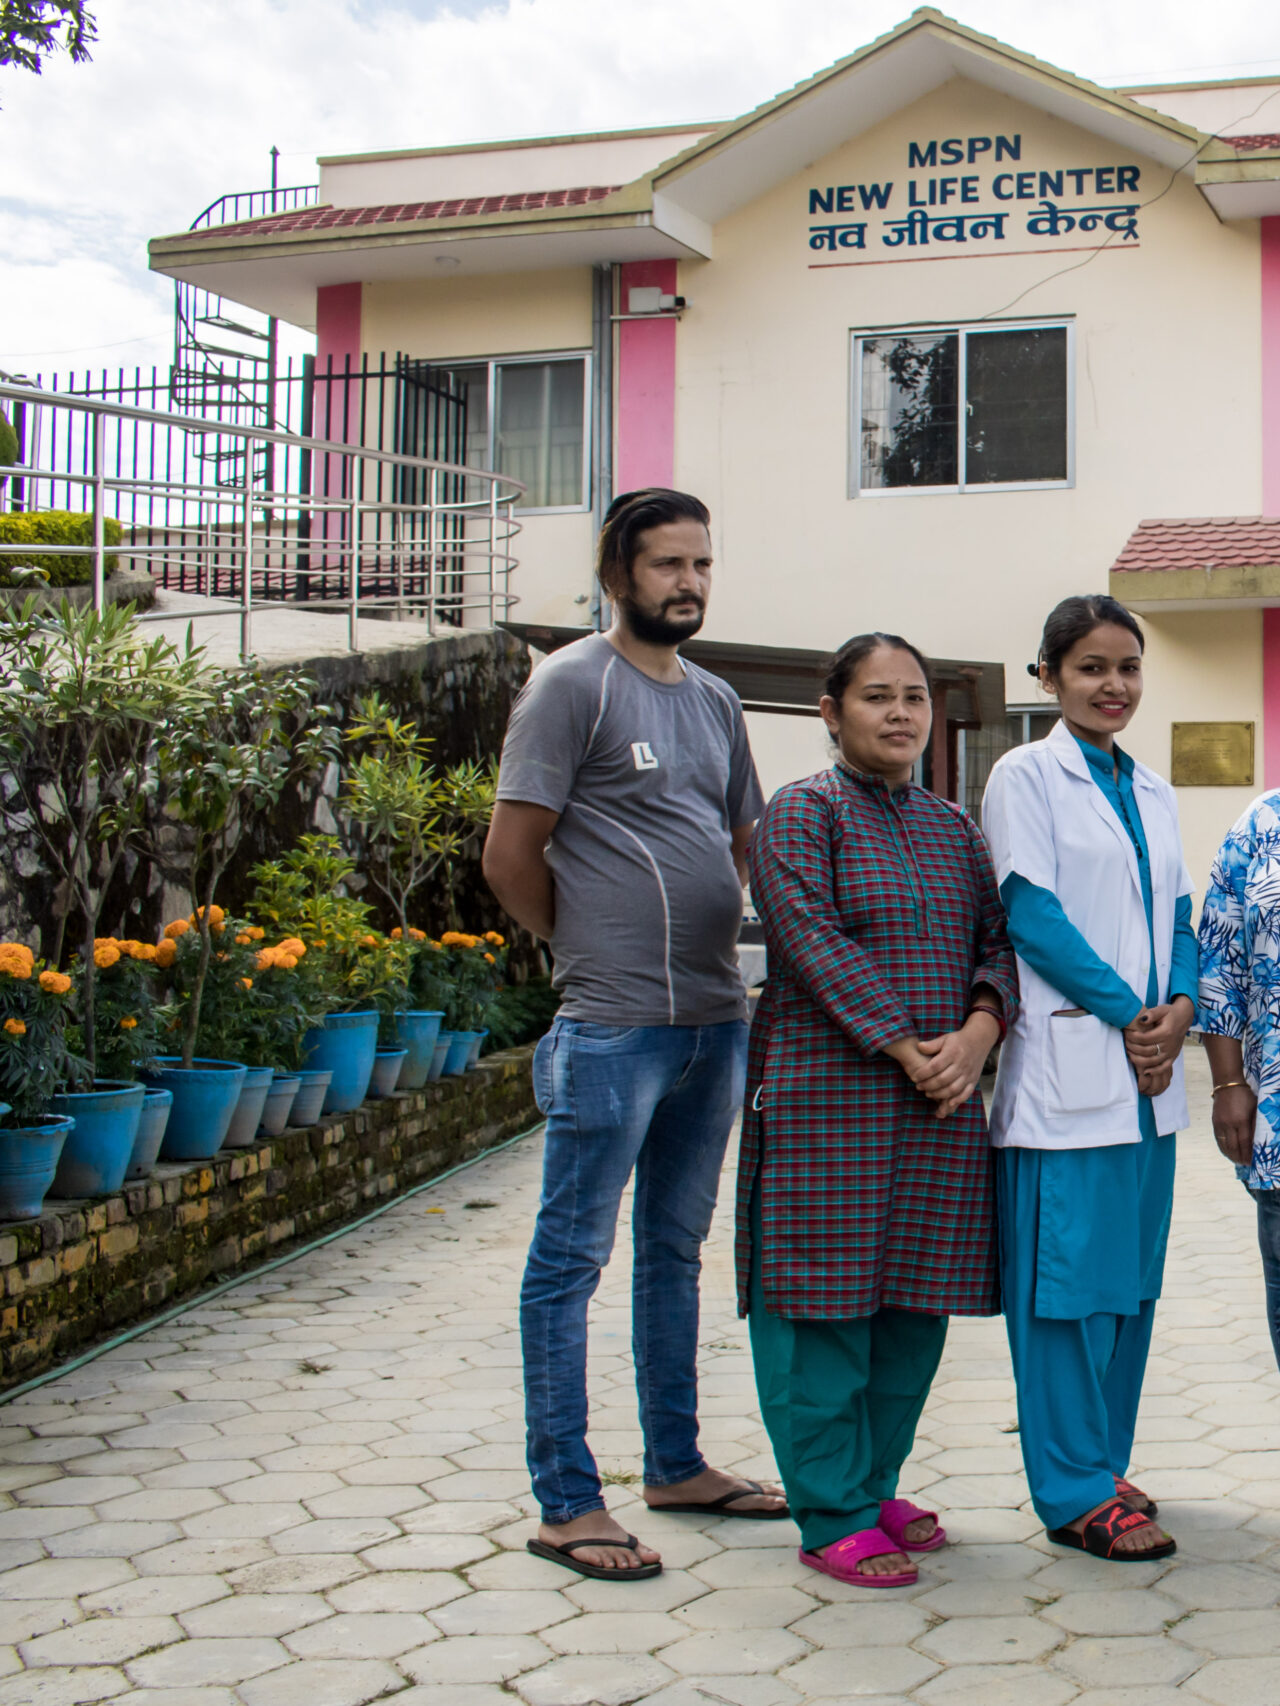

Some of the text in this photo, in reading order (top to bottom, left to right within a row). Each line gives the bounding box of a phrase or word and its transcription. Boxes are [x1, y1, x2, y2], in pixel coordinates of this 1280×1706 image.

[908, 134, 1021, 168] MSPN
[808, 165, 1142, 214] NEW LIFE CENTER
[808, 223, 868, 251] नव
[882, 209, 1010, 247] जीवन
